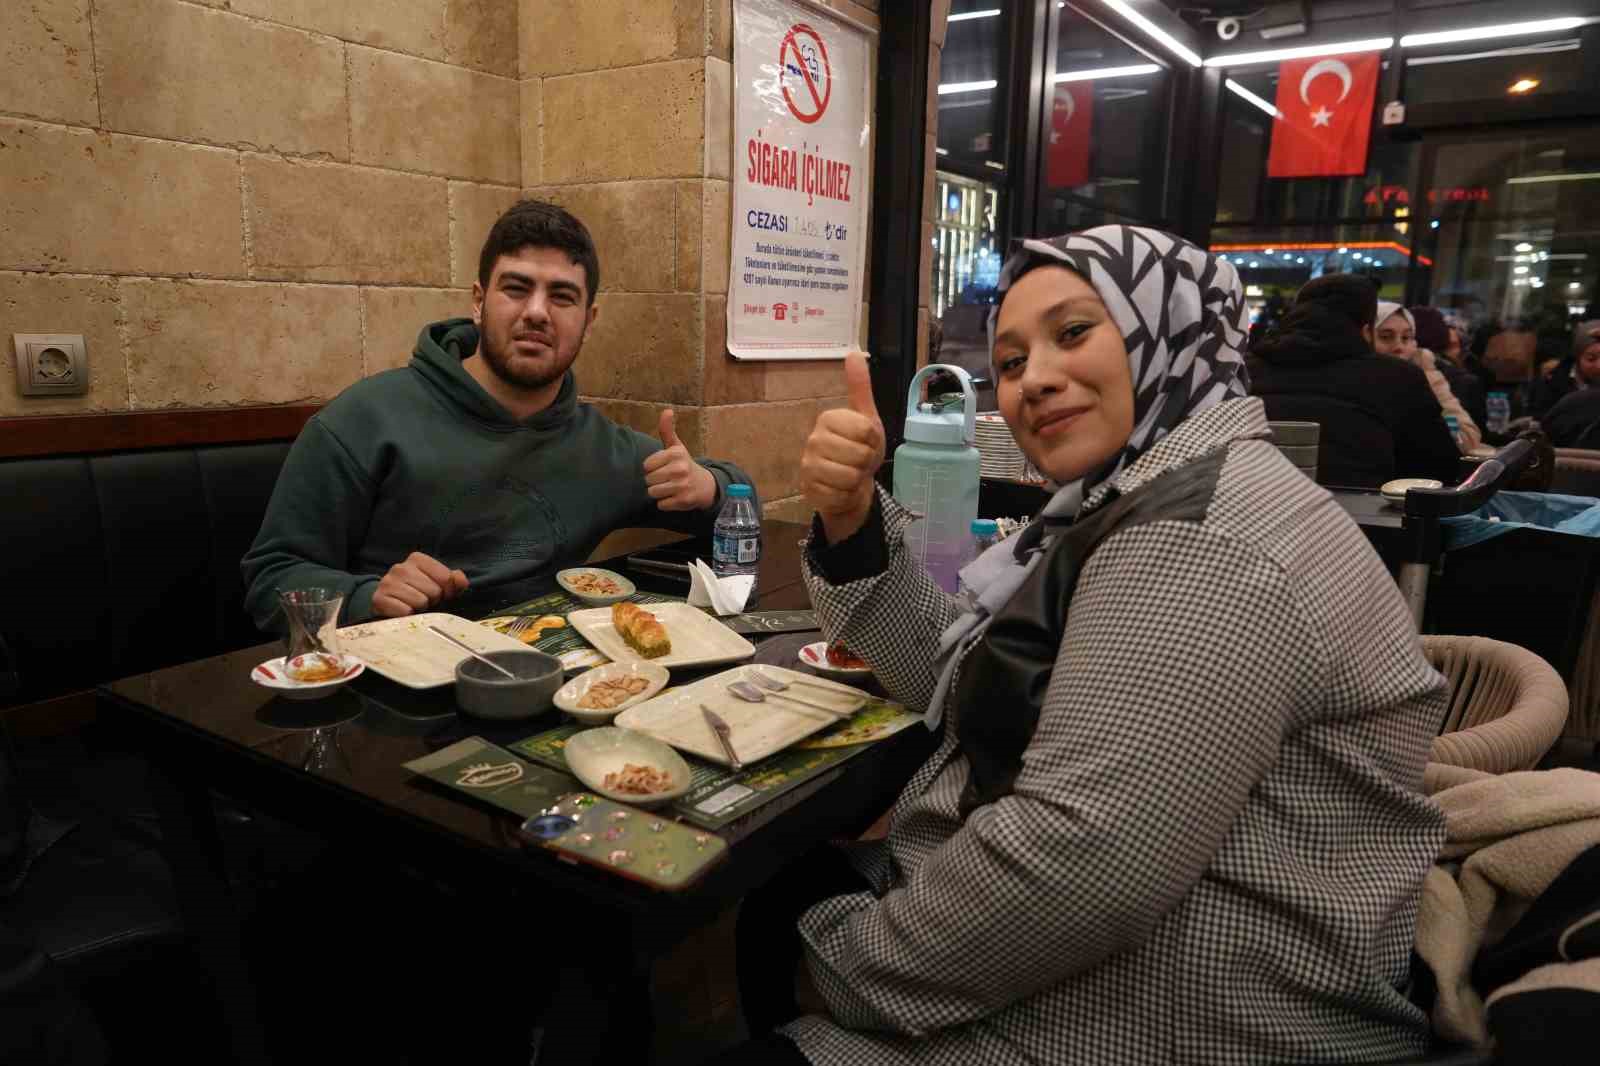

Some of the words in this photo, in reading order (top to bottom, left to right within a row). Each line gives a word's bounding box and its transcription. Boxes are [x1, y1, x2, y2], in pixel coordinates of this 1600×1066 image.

[748, 129, 797, 191] SİGARA
[802, 142, 852, 206] İÇİLMEZ
[747, 210, 788, 232] CEZASI
